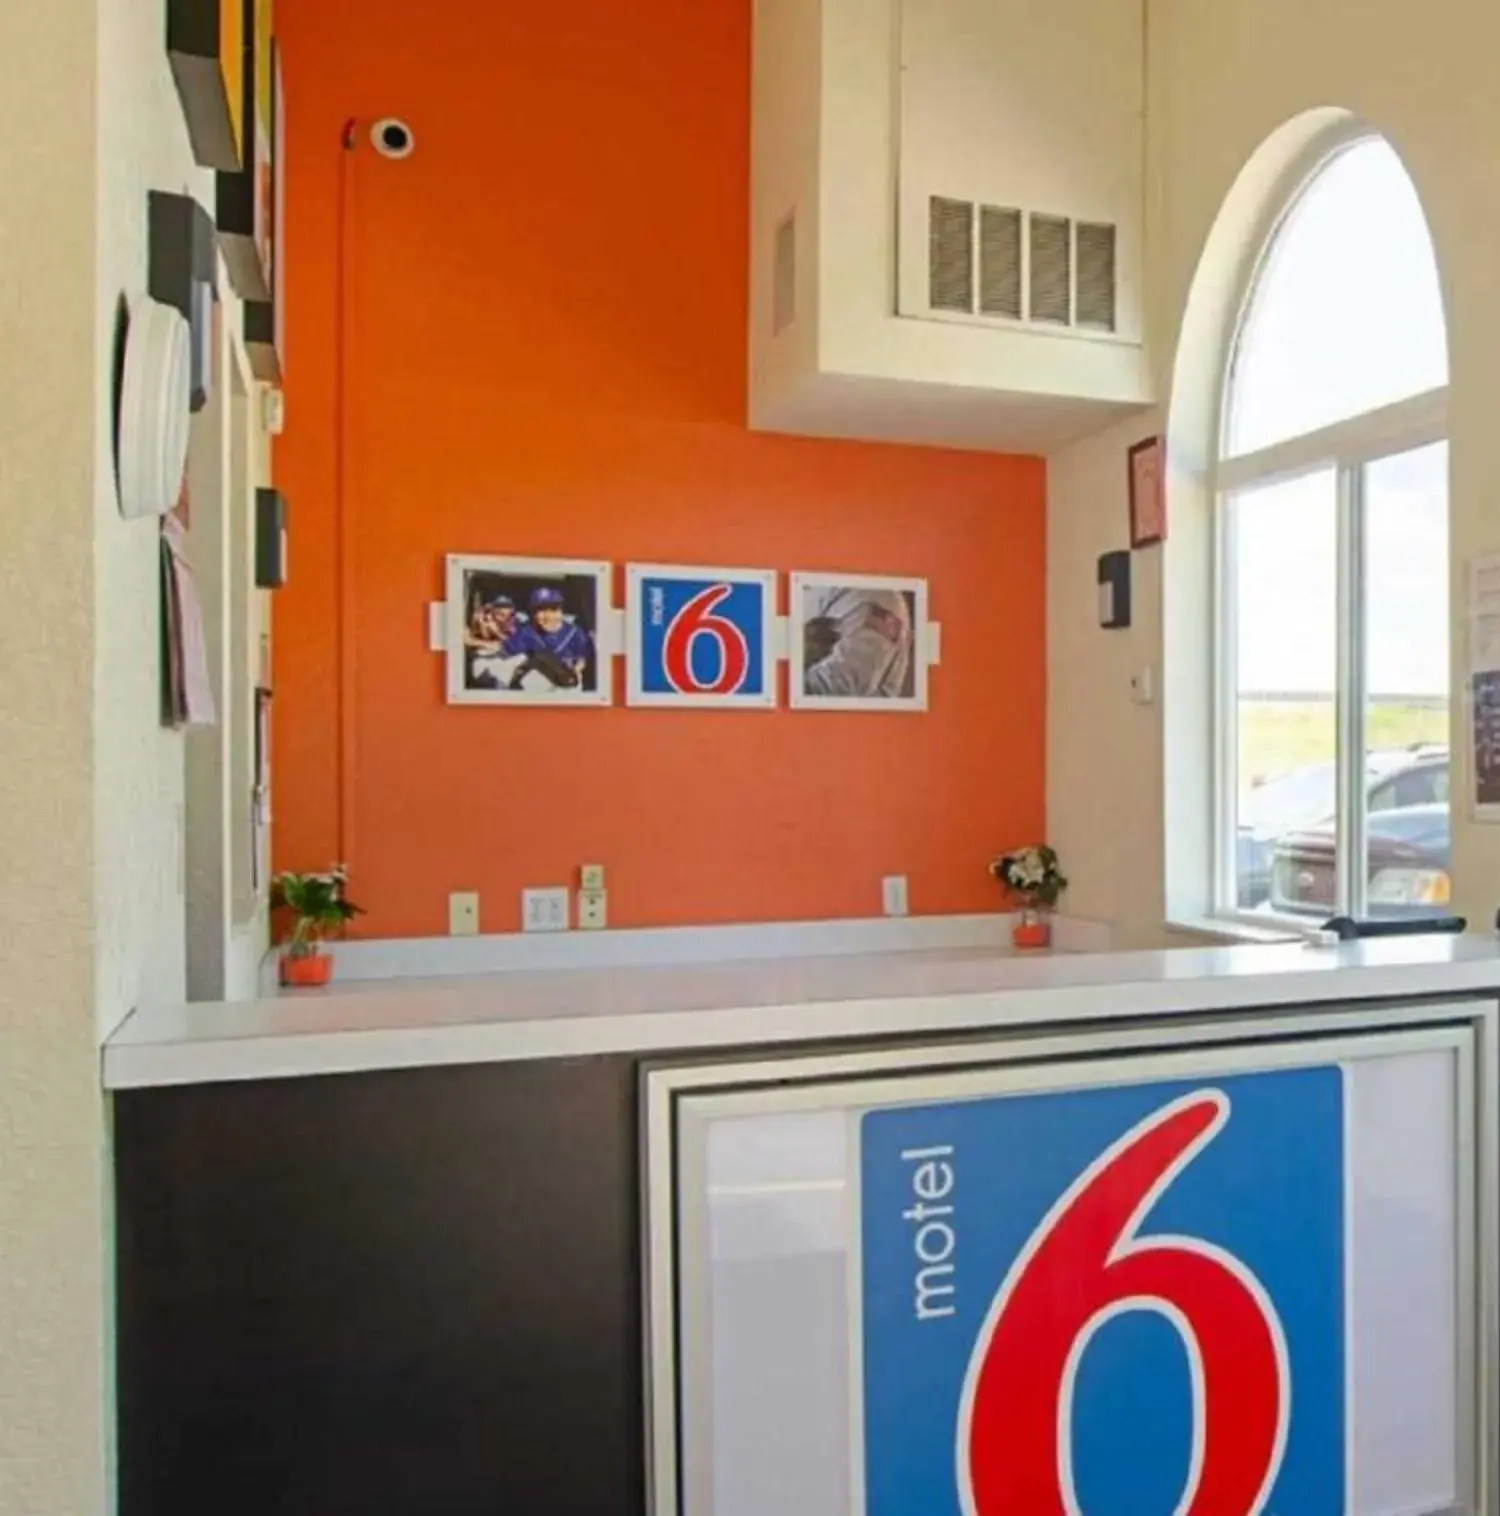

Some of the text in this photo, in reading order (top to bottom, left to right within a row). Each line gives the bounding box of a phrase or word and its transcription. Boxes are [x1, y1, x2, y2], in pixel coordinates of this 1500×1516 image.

[662, 583, 749, 697] 6
[902, 1145, 956, 1320] motel
[955, 1087, 1291, 1516] 6
